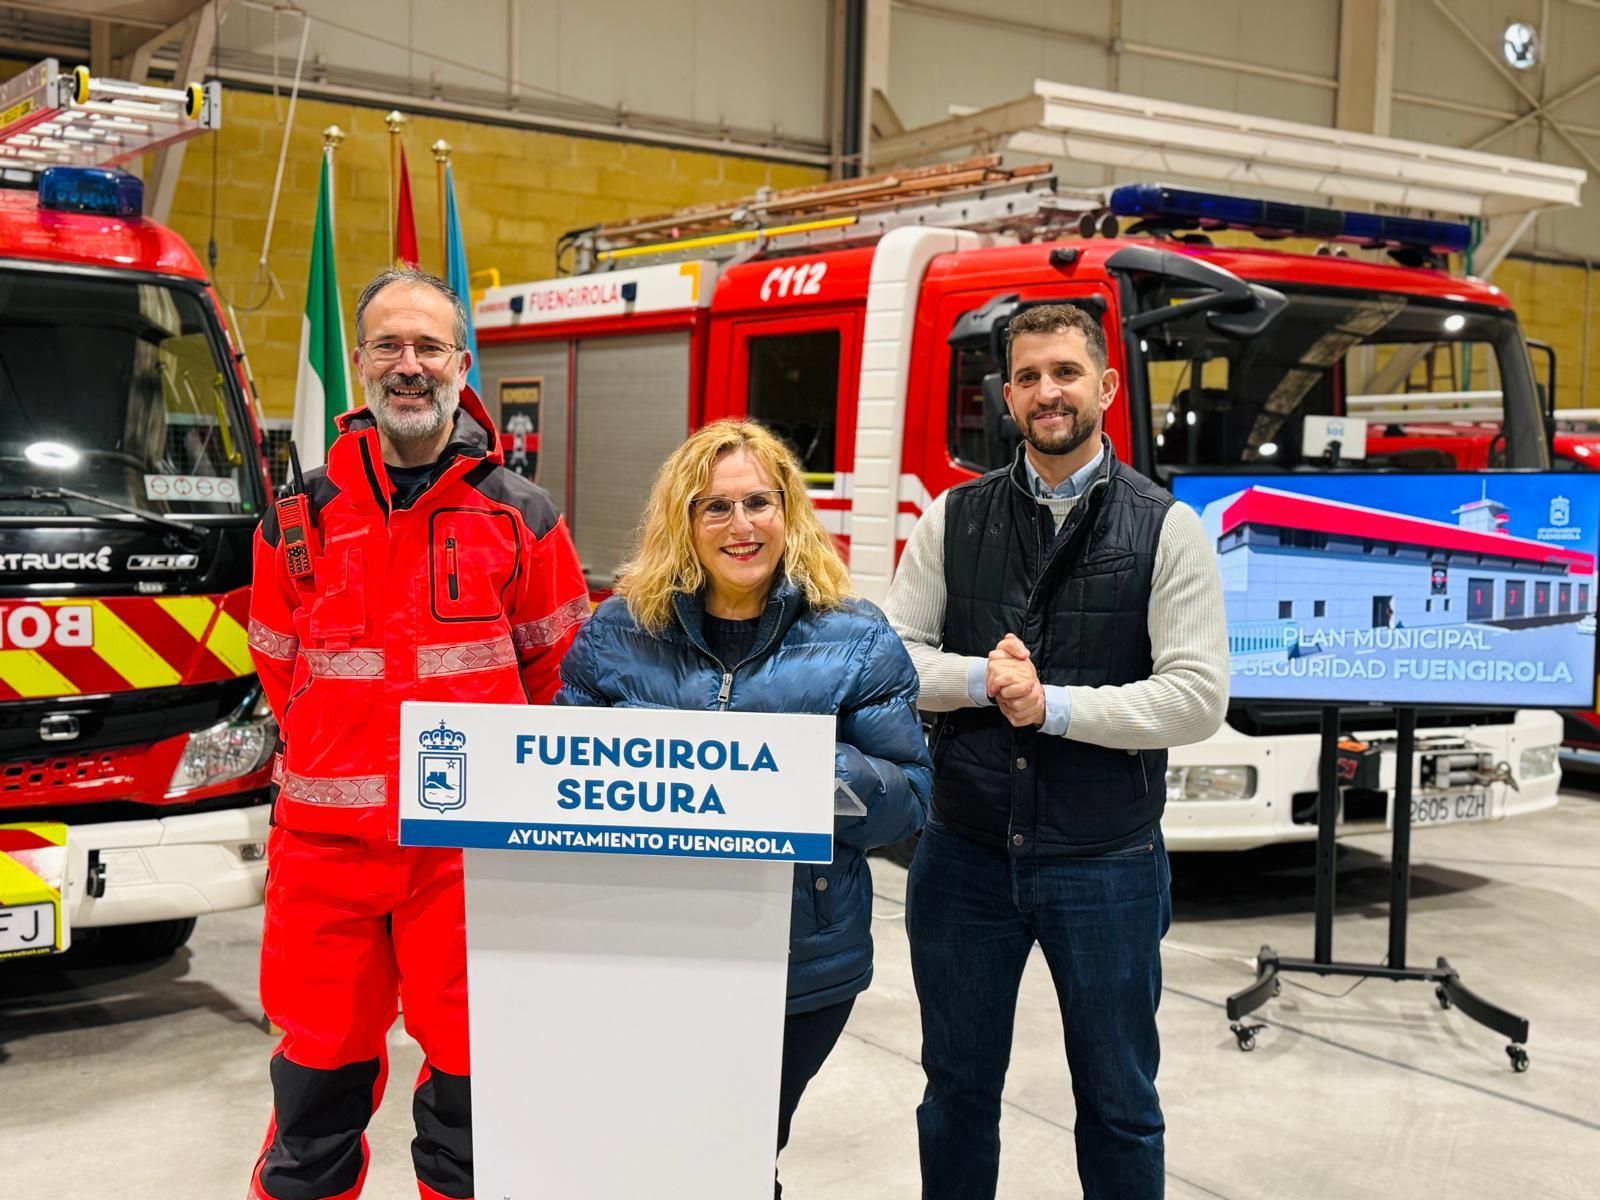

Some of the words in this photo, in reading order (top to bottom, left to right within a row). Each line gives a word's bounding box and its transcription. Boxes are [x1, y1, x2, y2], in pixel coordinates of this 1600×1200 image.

[778, 261, 827, 298] 112
[529, 282, 618, 311] FUENGIROLA
[1283, 628, 1345, 648] PLAN
[1353, 628, 1491, 650] MUNICIPAL
[1244, 658, 1386, 679] SEGURIDAD
[1393, 659, 1573, 683] FUENGIROLA
[515, 734, 779, 772] FUENGIROLA
[556, 778, 726, 815] SEGURA
[1455, 794, 1486, 818] CZH
[507, 829, 664, 850] AYUNTAMIENTO
[668, 833, 796, 855] FUENGIROLA
